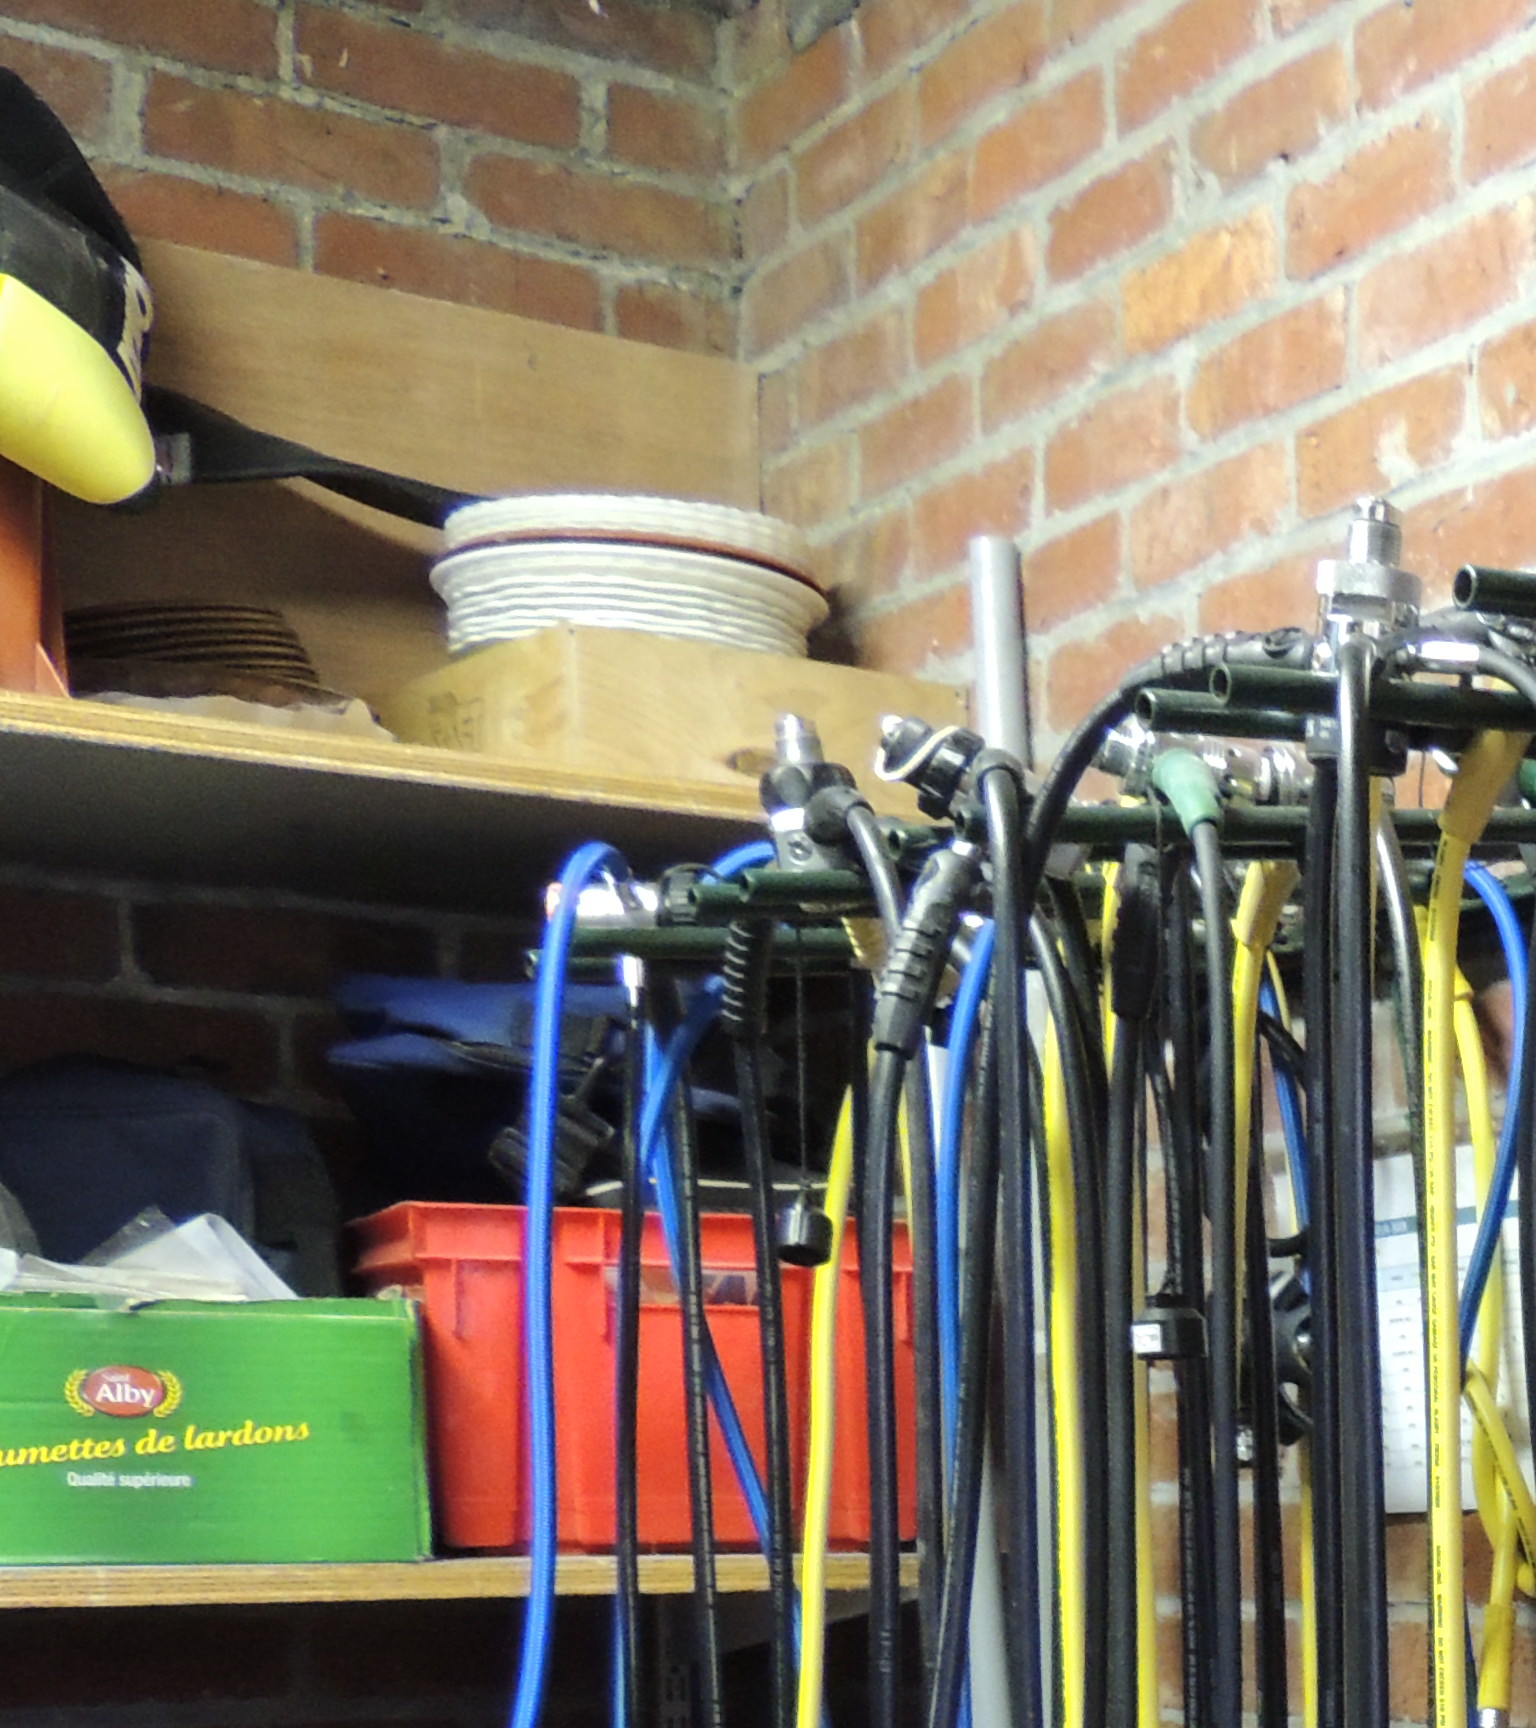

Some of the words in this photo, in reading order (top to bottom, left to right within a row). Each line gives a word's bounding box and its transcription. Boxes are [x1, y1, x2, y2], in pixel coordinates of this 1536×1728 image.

[95, 1383, 156, 1408] Alby
[135, 1428, 176, 1455] de
[184, 1420, 311, 1451] lardons
